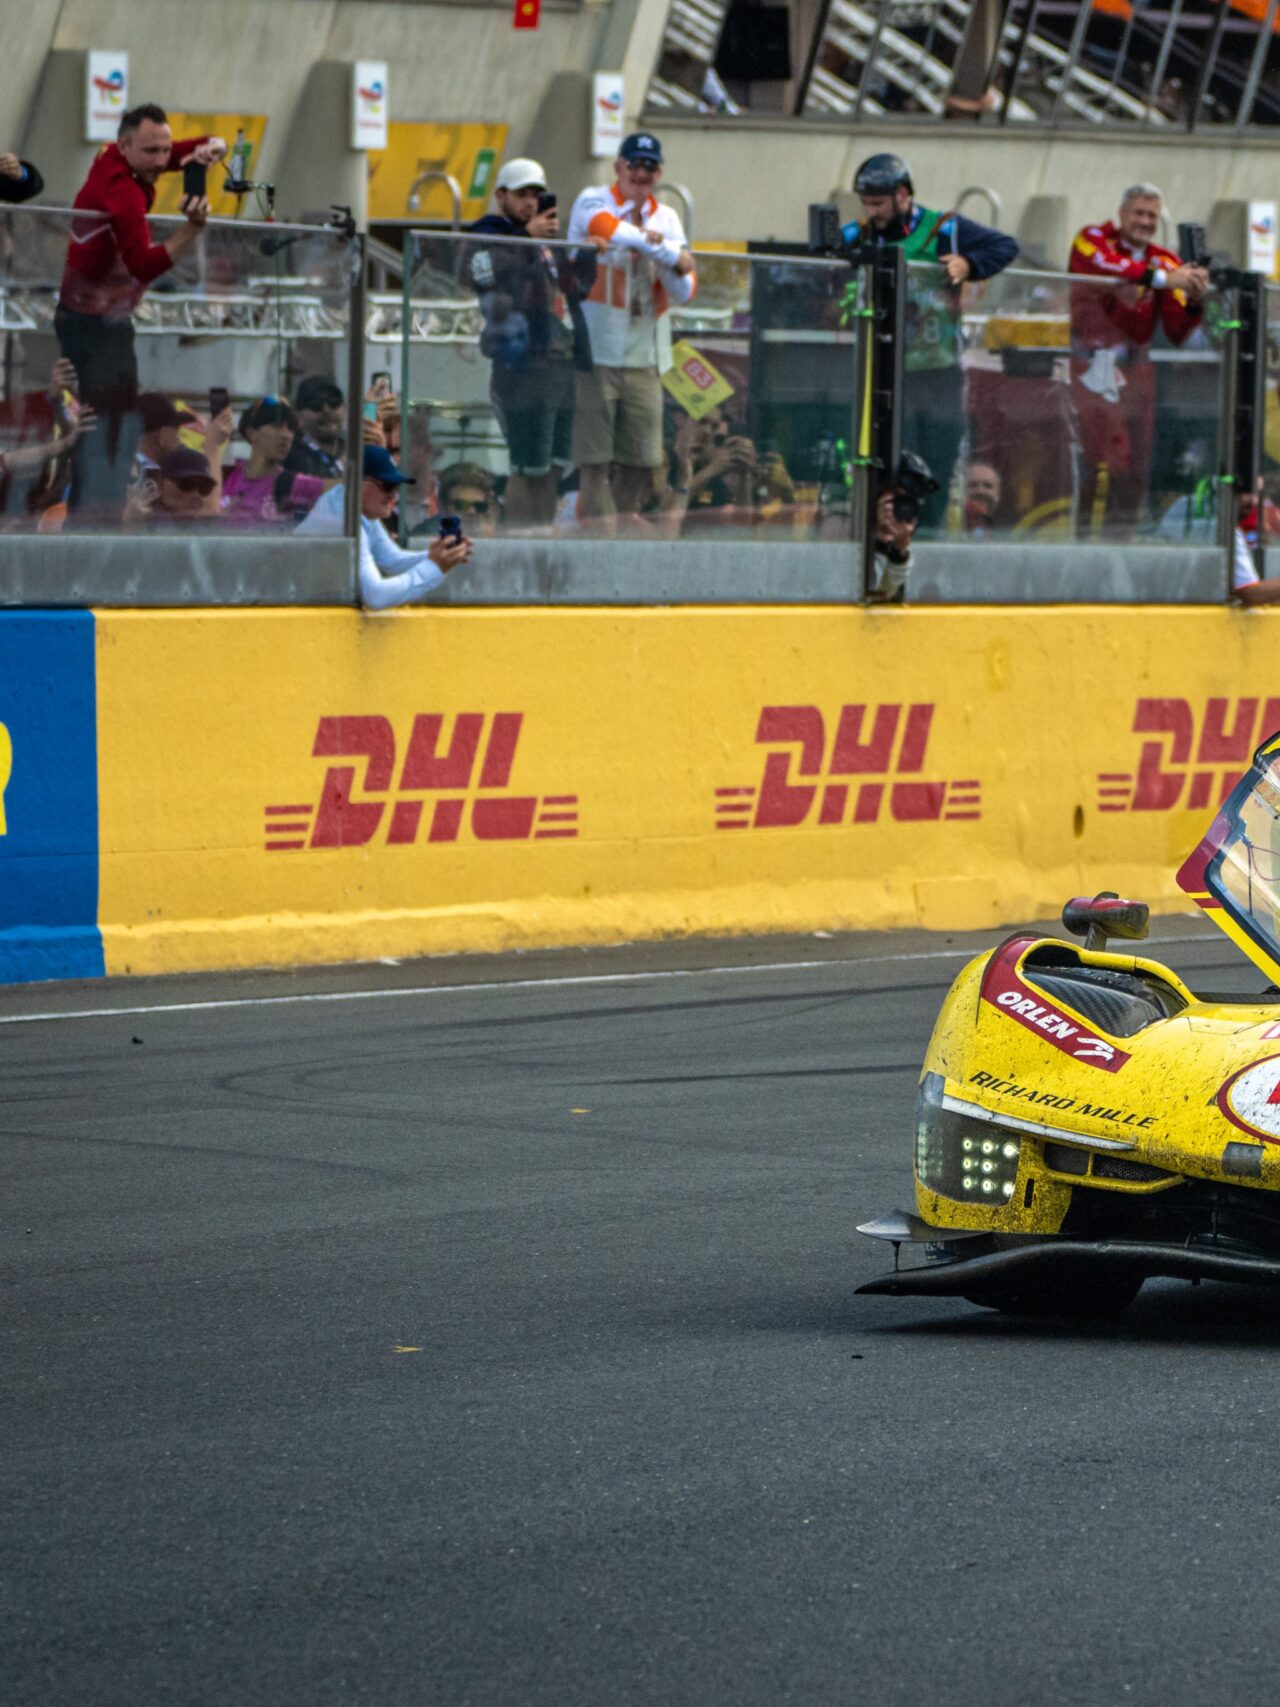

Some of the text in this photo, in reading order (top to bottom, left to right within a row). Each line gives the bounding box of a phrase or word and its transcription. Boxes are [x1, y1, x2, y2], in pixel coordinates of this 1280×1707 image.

[310, 712, 537, 849] DHL
[754, 703, 947, 828] DHL
[995, 990, 1078, 1041] ORLEN
[968, 1070, 1160, 1130] RICHARD MILLE
